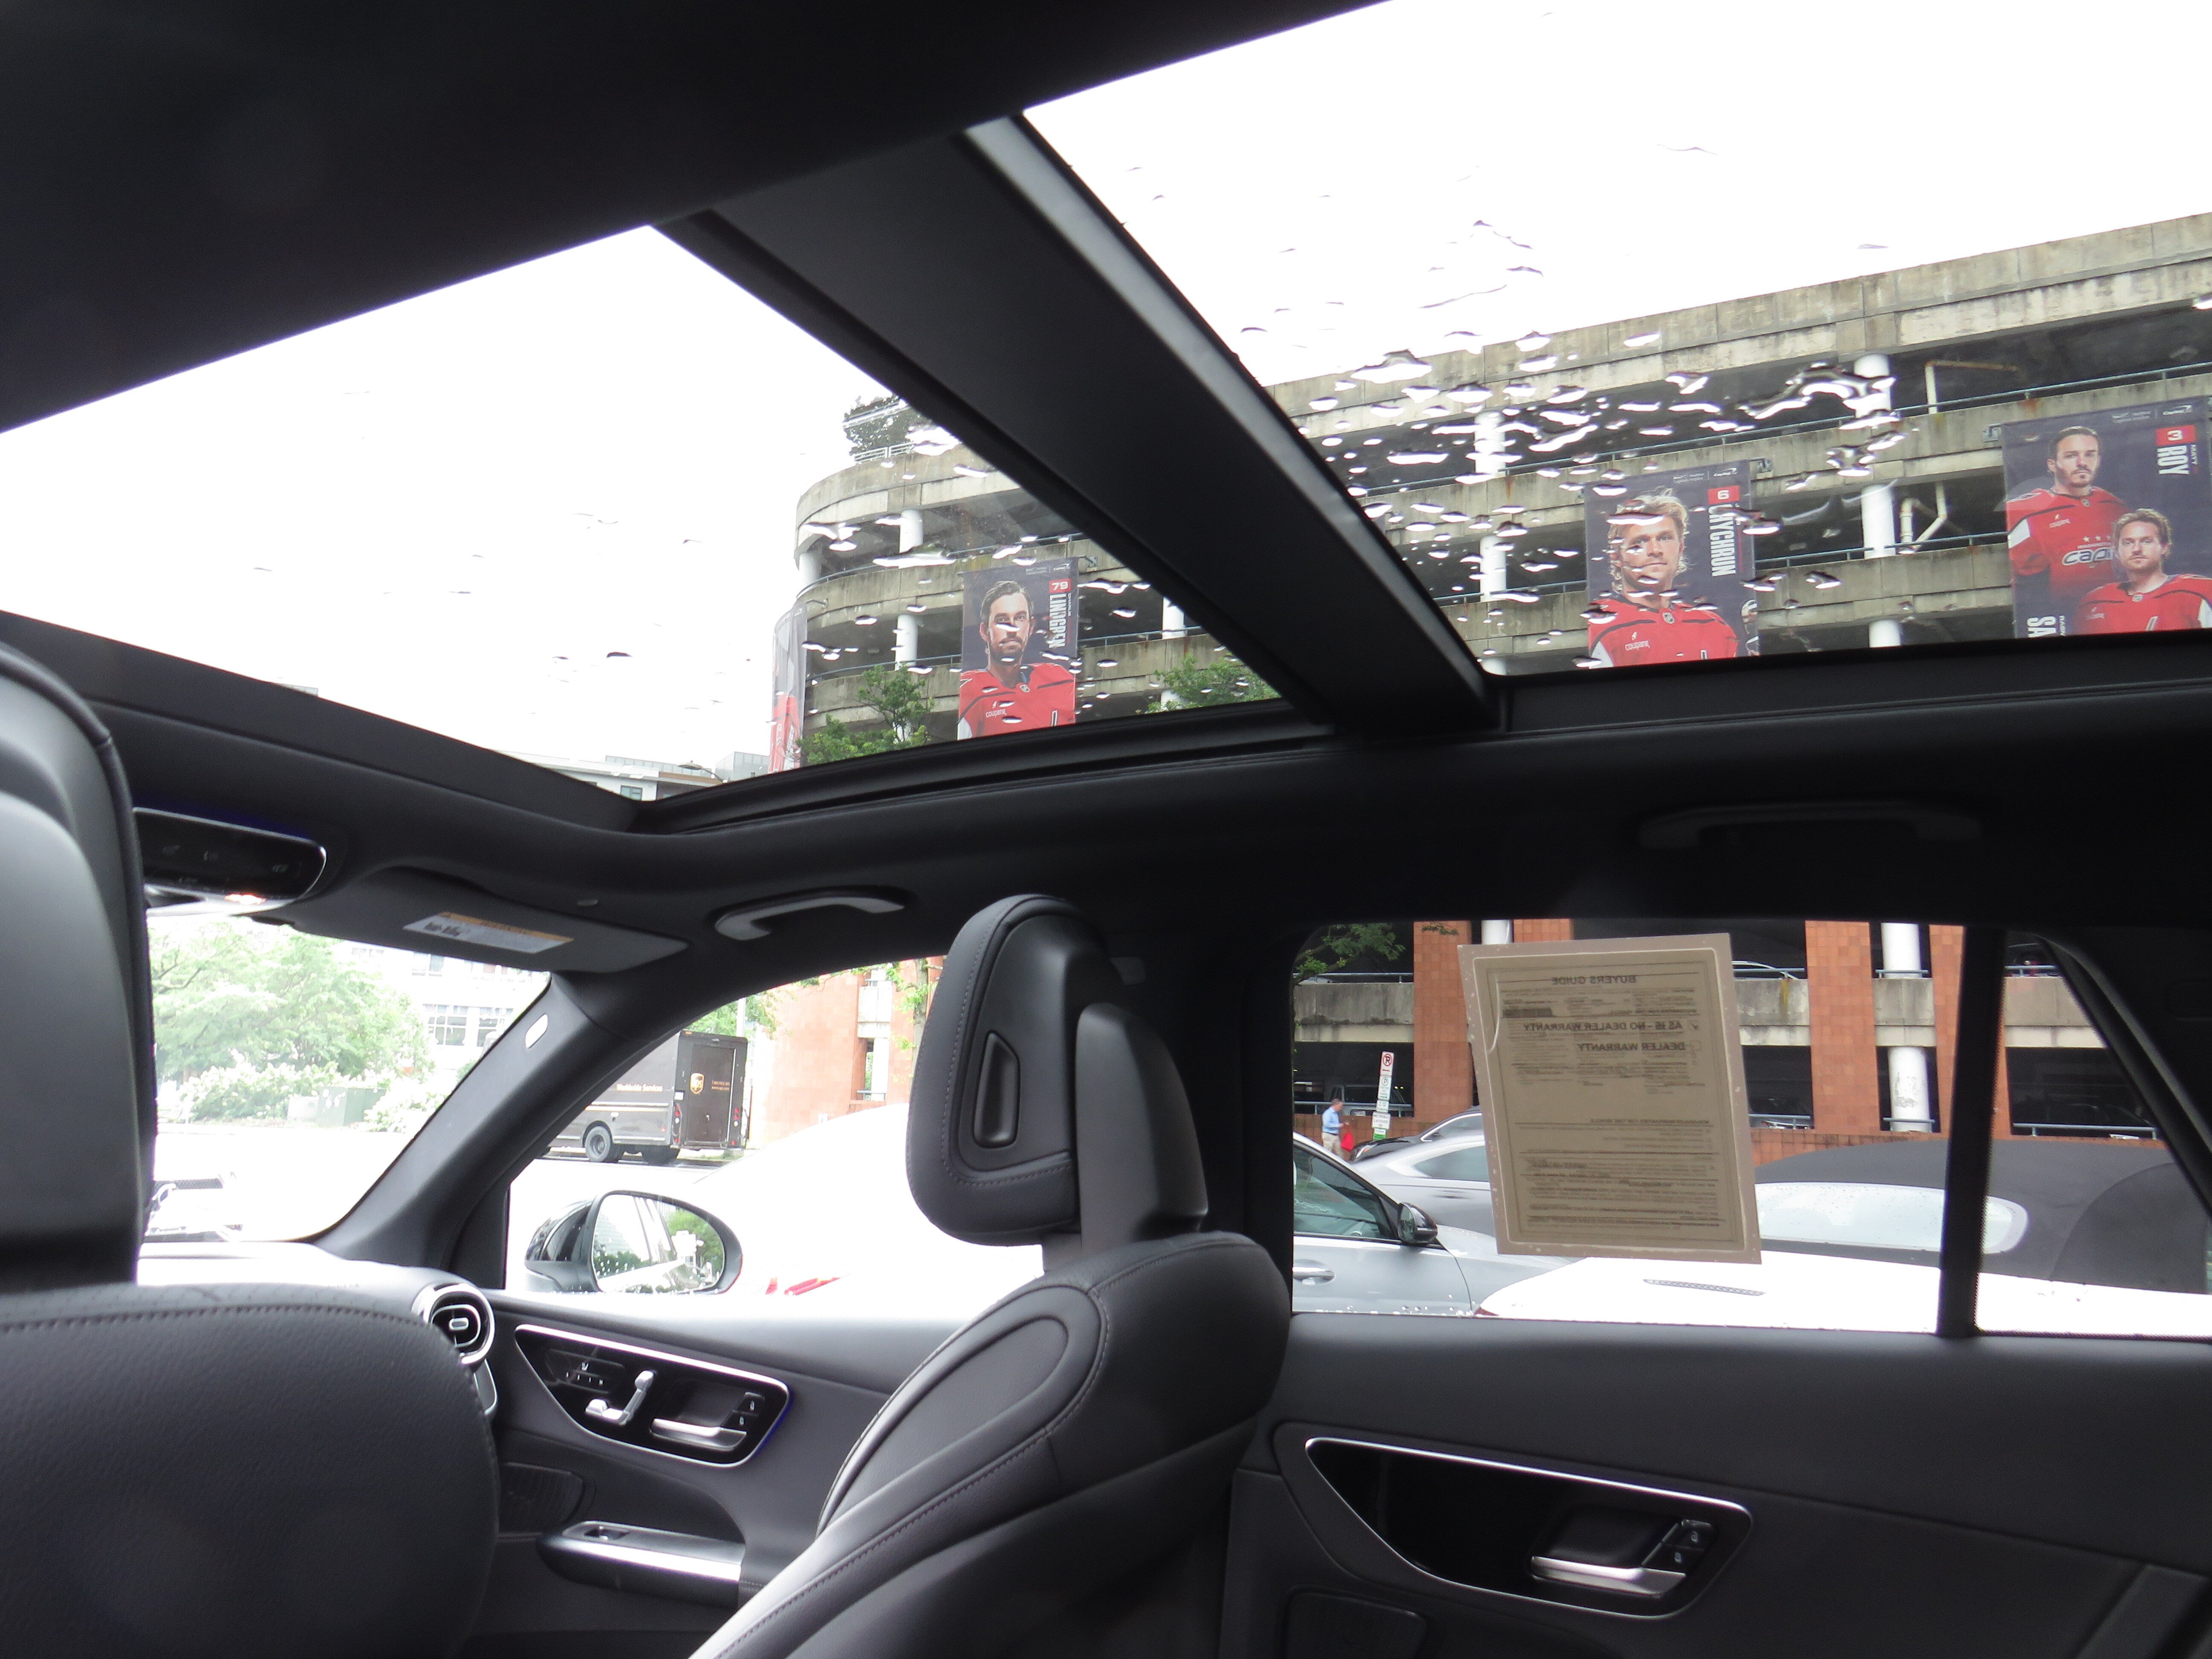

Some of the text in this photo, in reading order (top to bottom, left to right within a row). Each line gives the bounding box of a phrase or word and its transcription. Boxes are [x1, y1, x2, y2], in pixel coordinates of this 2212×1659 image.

[2167, 430, 2183, 441] 3
[2157, 445, 2190, 475] ROY
[1717, 489, 1730, 500] 6
[1051, 581, 1069, 591] 79
[1048, 593, 1067, 648] LINDGREN
[1624, 640, 1650, 651] coupang
[985, 708, 1007, 718] coupang
[642, 1083, 663, 1092] Services
